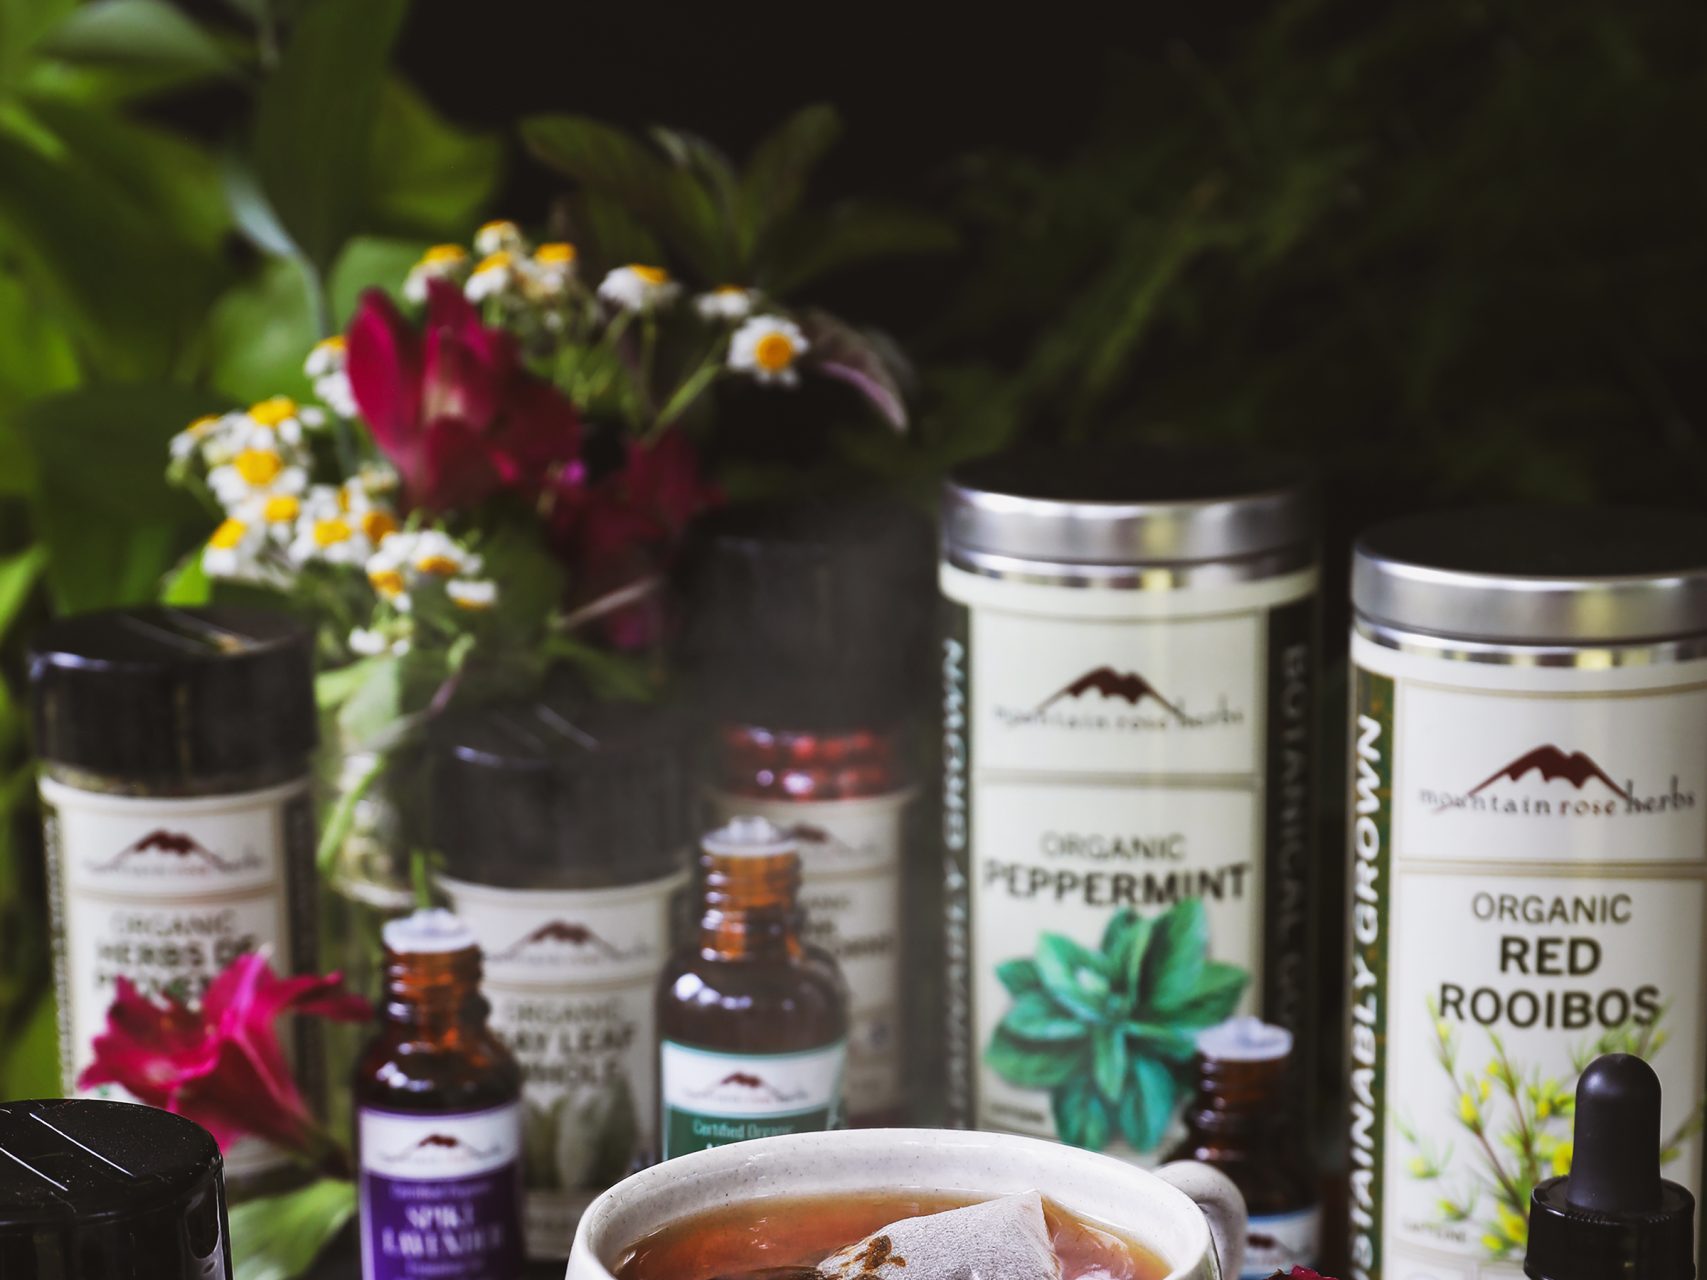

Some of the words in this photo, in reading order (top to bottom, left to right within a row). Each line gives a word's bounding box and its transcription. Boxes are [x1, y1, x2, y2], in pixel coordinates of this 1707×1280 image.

[1418, 788, 1551, 815] mountain
[1559, 797, 1617, 816] rose
[1624, 774, 1695, 815] herbs
[1040, 831, 1187, 860] ORGANIC
[1354, 713, 1382, 945] GROWN
[983, 858, 1251, 907] PEPPERMINT
[1472, 892, 1632, 924] ORGANIC
[1498, 935, 1602, 976] RED
[1438, 982, 1661, 1031] ROOIBOS
